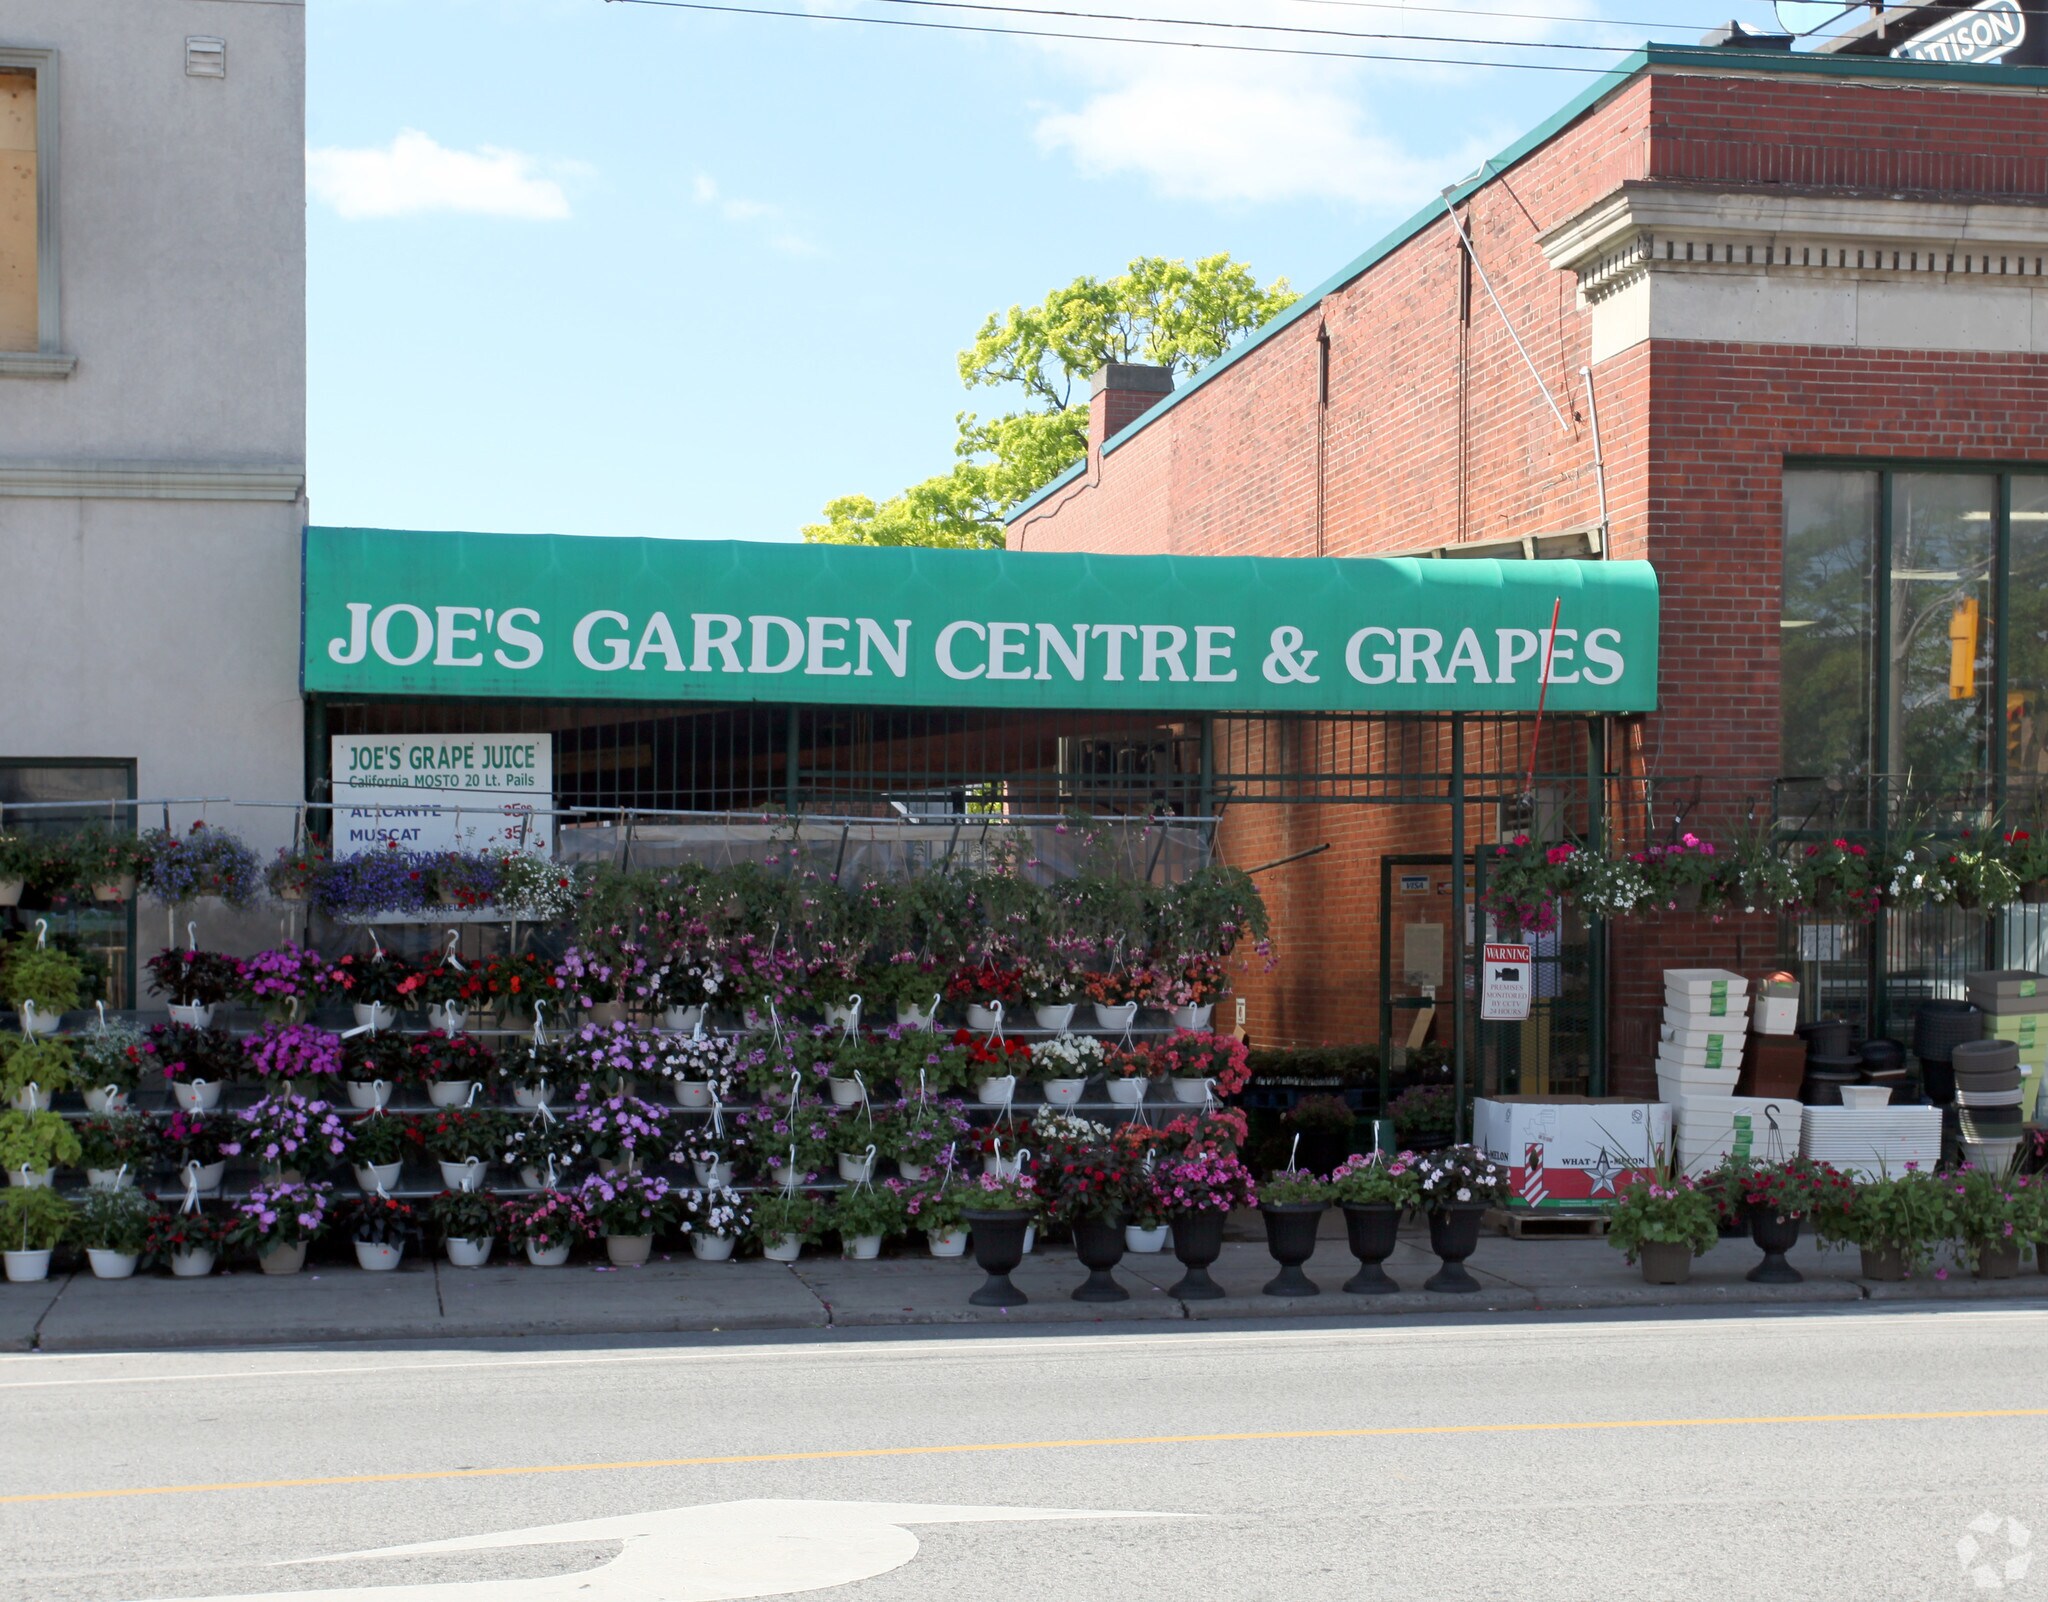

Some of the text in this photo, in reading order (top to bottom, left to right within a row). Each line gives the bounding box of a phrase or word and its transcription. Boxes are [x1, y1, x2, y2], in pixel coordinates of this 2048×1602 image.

[328, 603, 1624, 685] JOE'S GARDEN CENTRE & GRAPES
[349, 745, 535, 771] JOE'S GRAPE JUICE
[349, 773, 535, 788] California MOSTO 20 Lt. Pails
[350, 828, 421, 842] MUSCAT
[1406, 881, 1424, 889] VISA
[1486, 947, 1529, 960] WARNING
